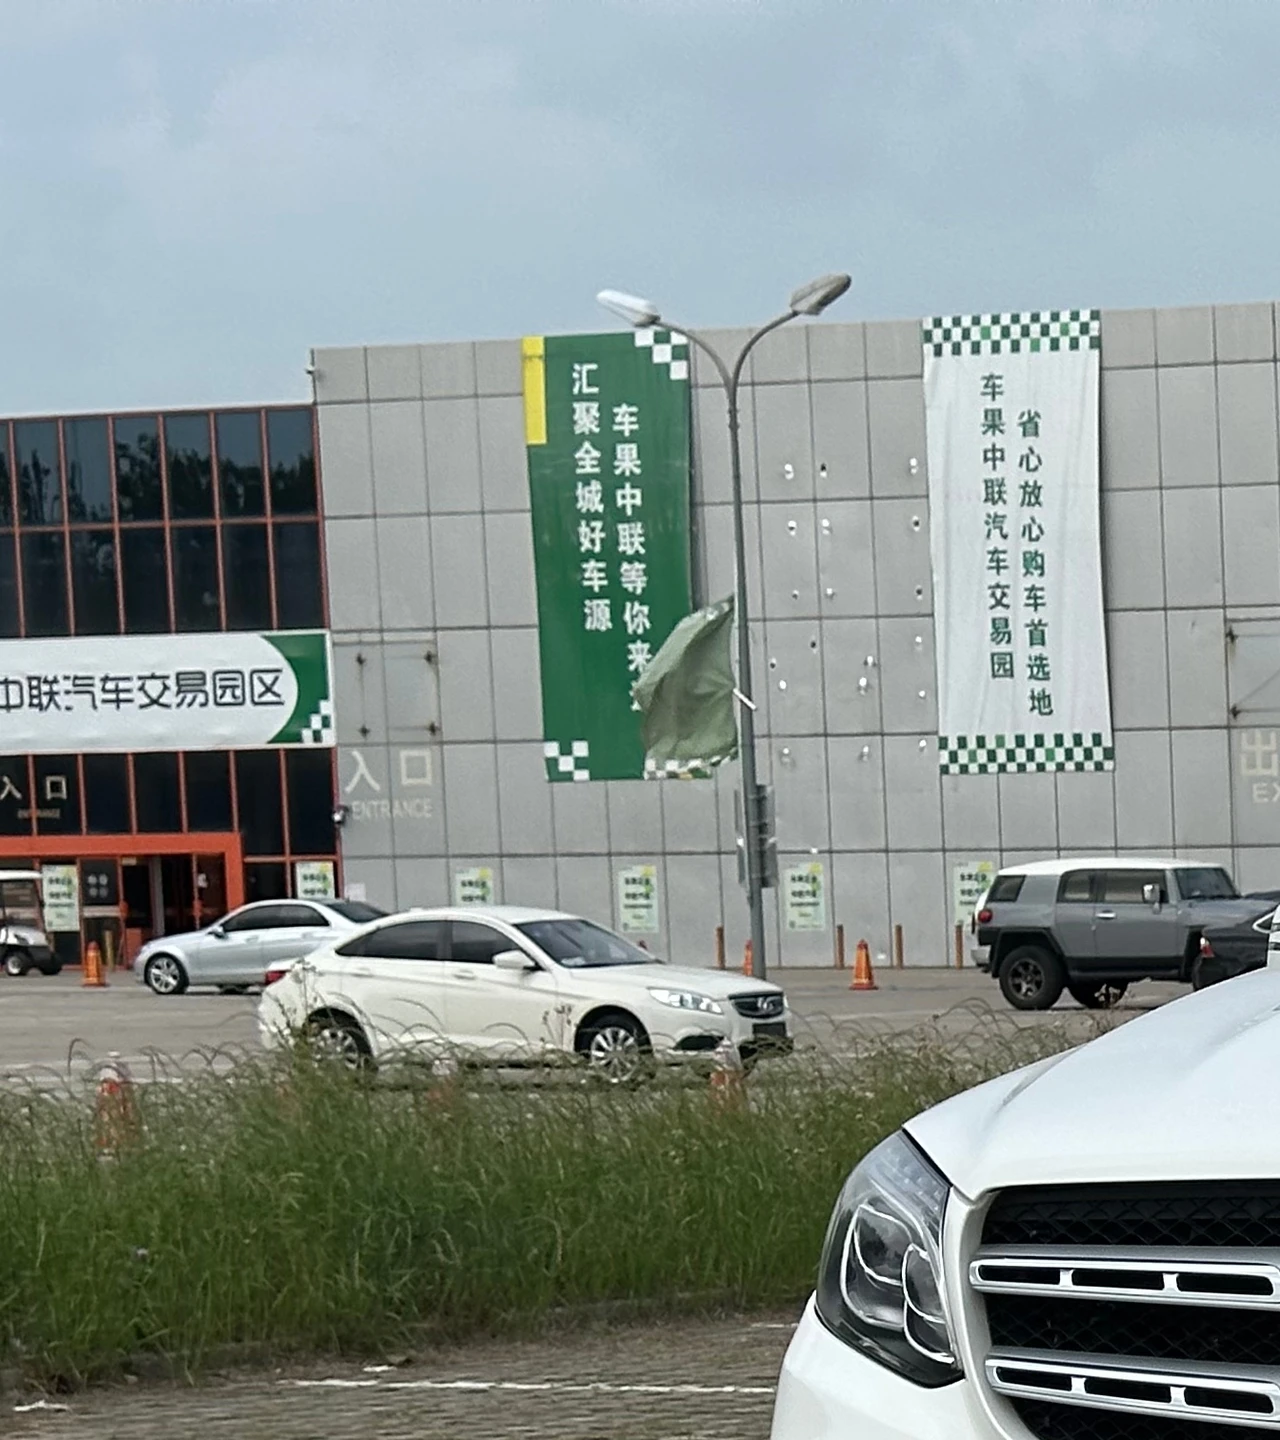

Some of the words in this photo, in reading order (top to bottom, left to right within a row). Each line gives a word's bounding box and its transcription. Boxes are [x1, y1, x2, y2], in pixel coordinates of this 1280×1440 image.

[572, 363, 613, 631] 汇聚全城好车源
[612, 403, 652, 711] 车果中联等你来
[980, 372, 1014, 679] 车果中联汽车交易园
[1017, 409, 1054, 716] 省心放心购车首选地
[0, 668, 285, 713] 中联汽车交易园区
[0, 775, 67, 800] 入口
[345, 750, 432, 793] 入口
